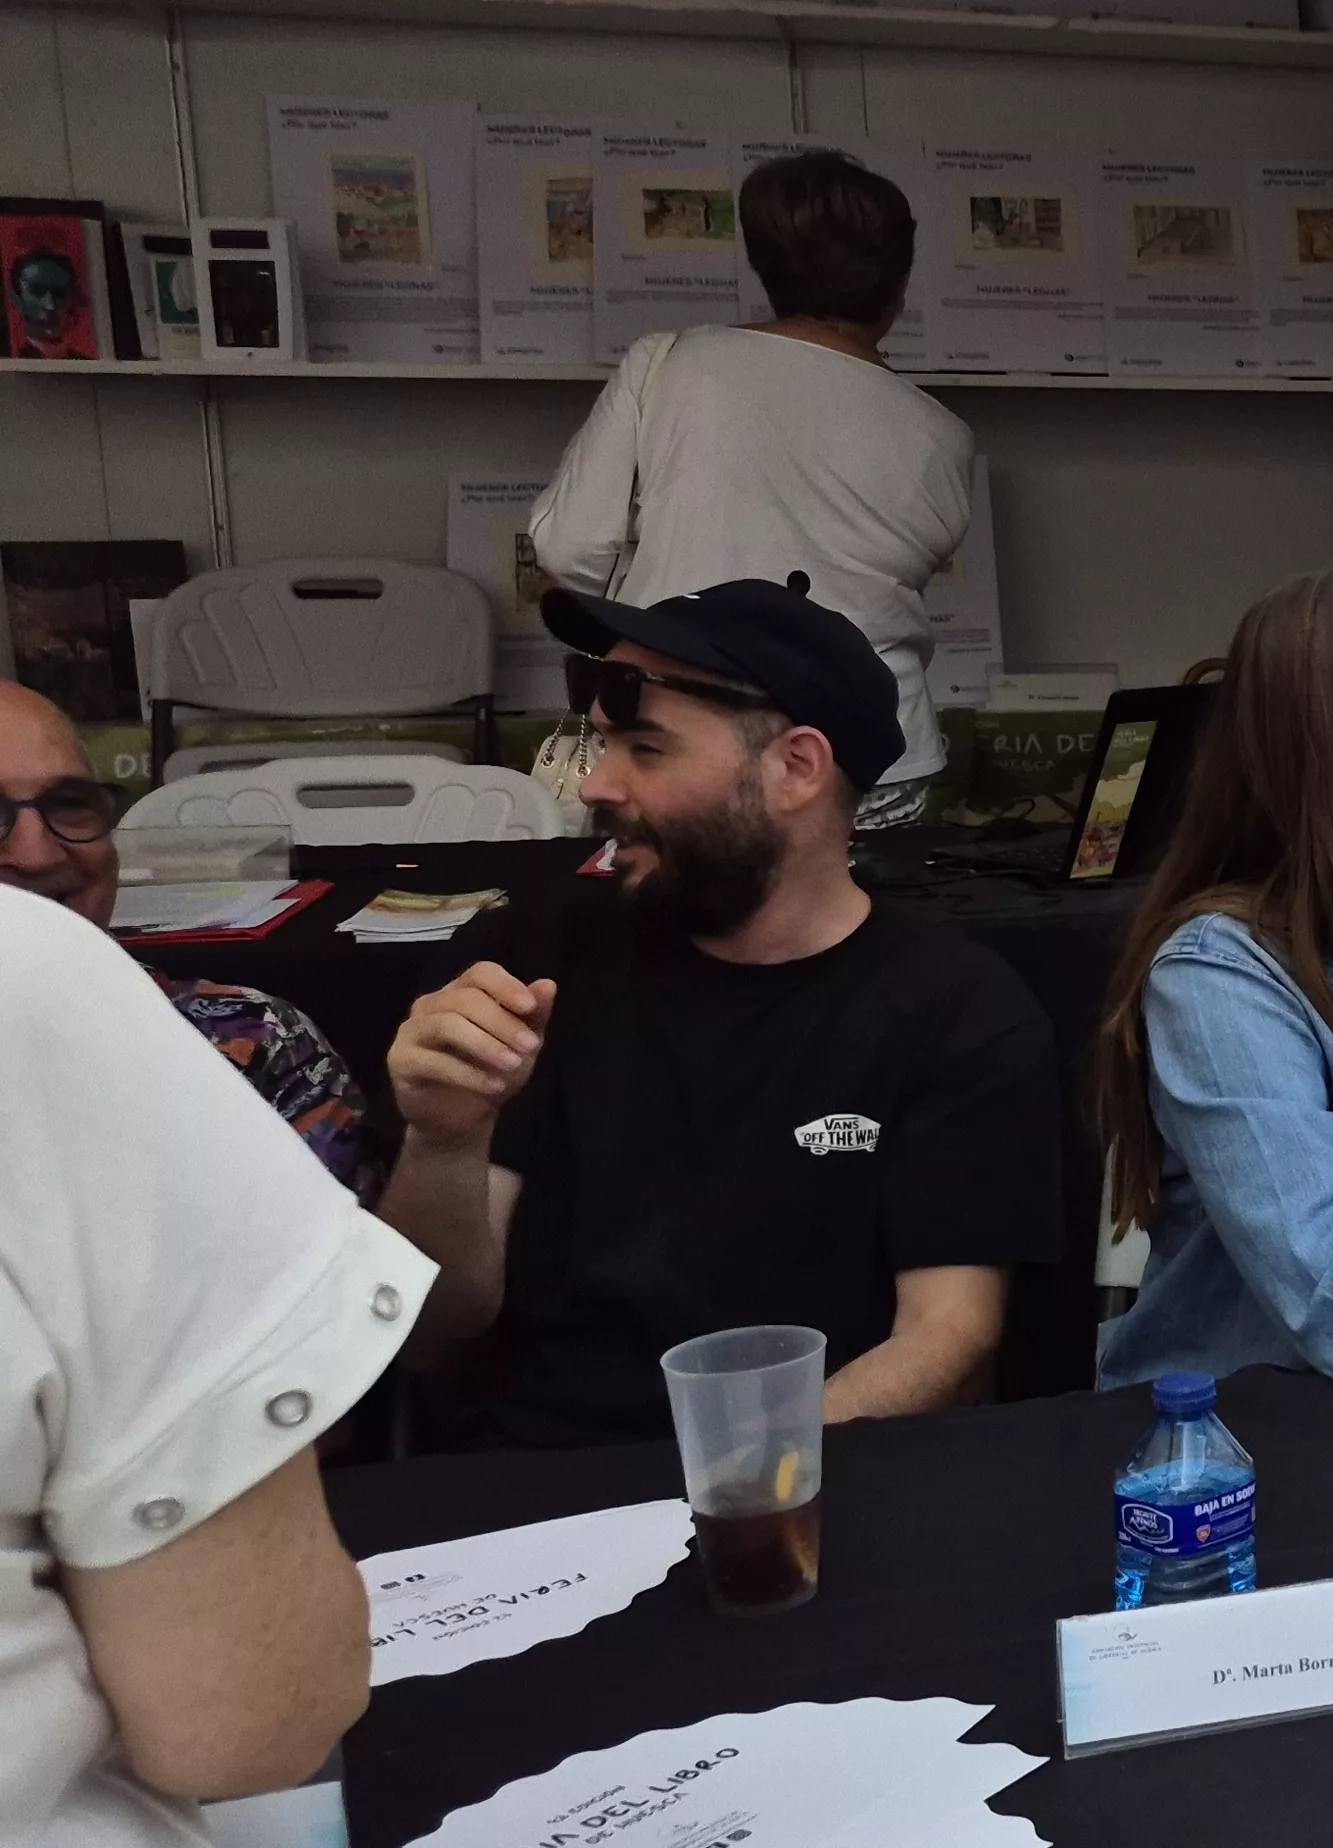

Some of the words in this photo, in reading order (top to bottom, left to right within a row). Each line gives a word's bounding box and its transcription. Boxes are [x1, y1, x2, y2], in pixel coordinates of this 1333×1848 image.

[824, 1117, 859, 1131] VANS
[828, 1130, 853, 1146] THE
[1194, 1501, 1220, 1516] BAJA
[1221, 1494, 1235, 1508] EN
[499, 1572, 588, 1605] FERIA
[425, 1605, 488, 1628] DEL
[370, 1627, 416, 1648] LIB
[1242, 1664, 1293, 1681] Marta
[580, 1799, 649, 1829] DEL
[649, 1748, 740, 1793] LIBRO
